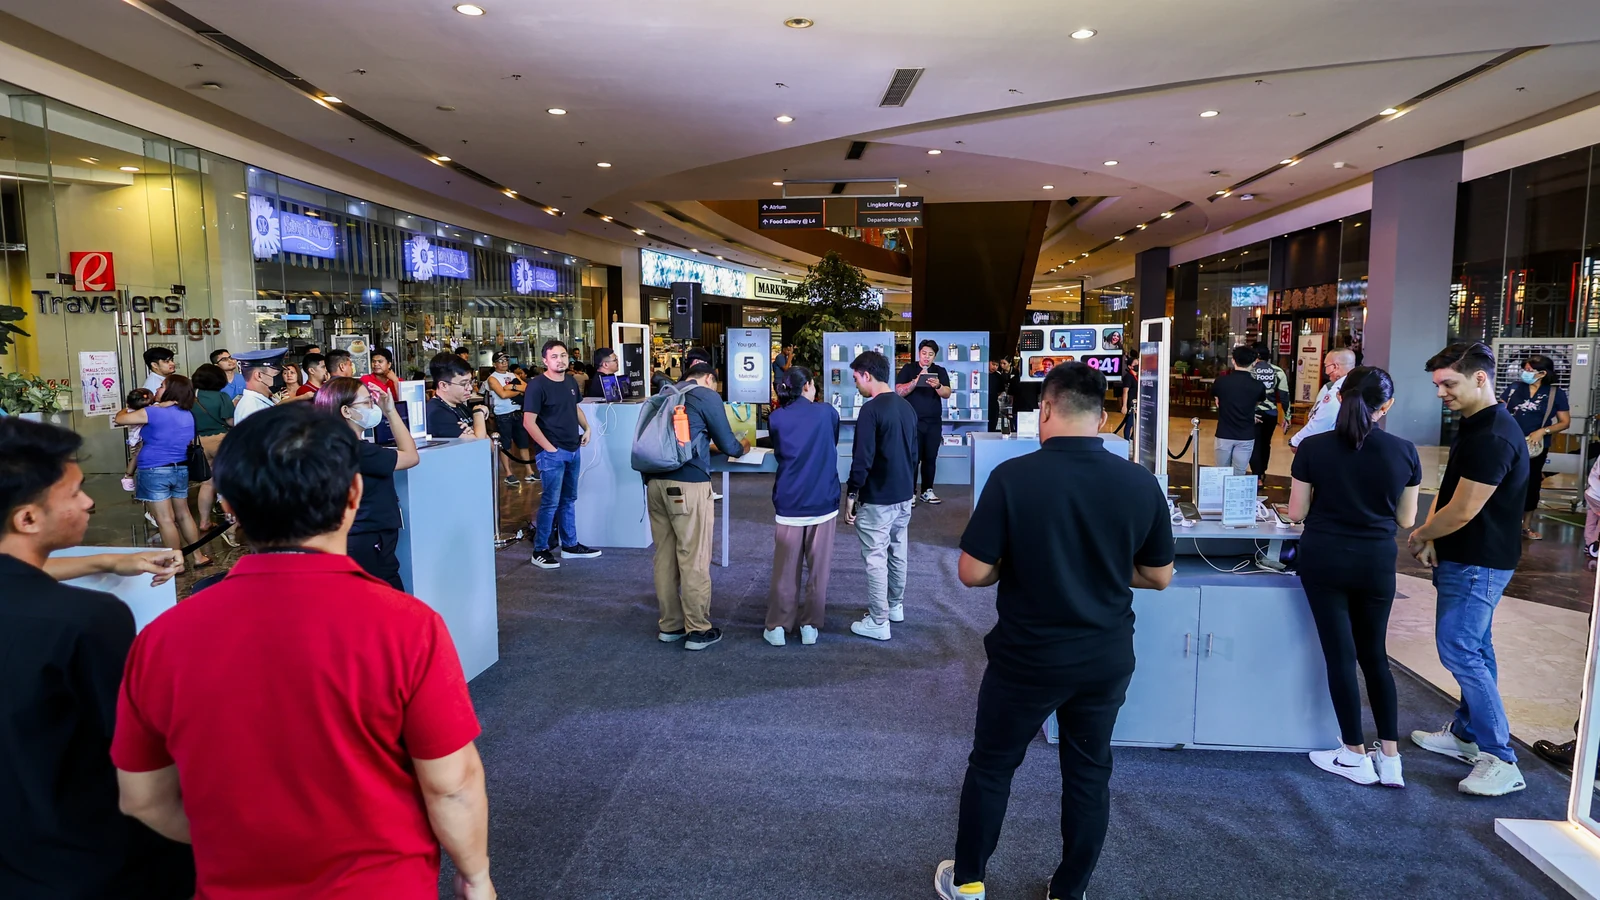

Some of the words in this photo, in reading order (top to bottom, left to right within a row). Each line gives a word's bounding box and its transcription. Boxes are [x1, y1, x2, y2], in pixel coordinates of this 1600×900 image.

[31, 289, 182, 315] Travellers
[743, 356, 755, 371] 5
[1087, 357, 1120, 374] 9:41
